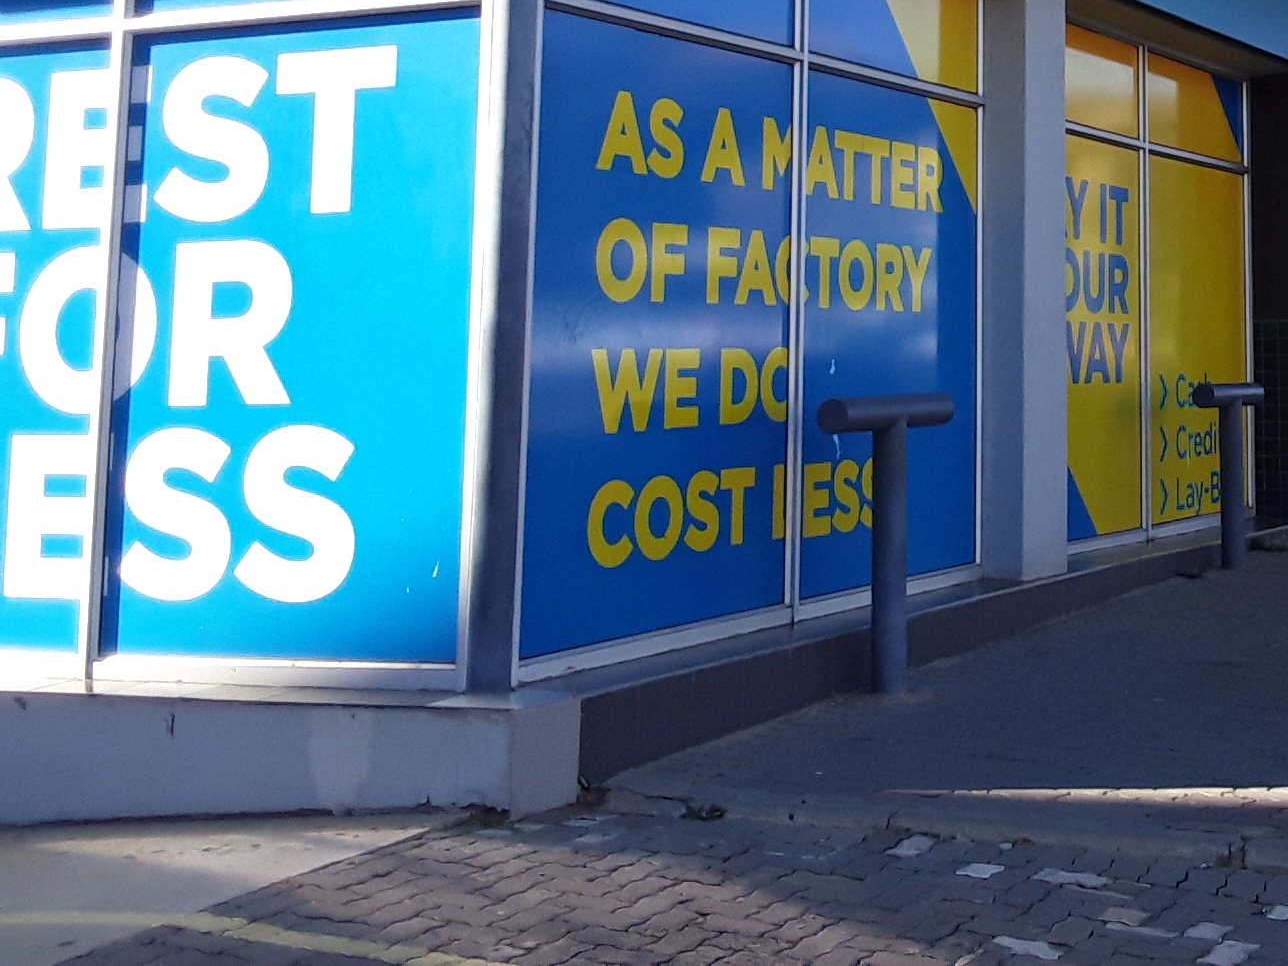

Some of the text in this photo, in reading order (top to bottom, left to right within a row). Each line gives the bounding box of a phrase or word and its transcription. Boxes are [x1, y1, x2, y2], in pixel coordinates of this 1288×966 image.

[0, 44, 398, 232] EST
[596, 90, 943, 212] AS A MATTER
[1100, 183, 1130, 246] IT
[595, 217, 932, 312] OF FACTORY
[1066, 247, 1130, 315] OUR
[0, 239, 294, 416] OR
[591, 346, 788, 434] WE DO
[1176, 421, 1218, 459] Credi
[2, 425, 356, 604] ESS
[587, 467, 756, 568] COST
[1176, 471, 1220, 515] Lay-B
